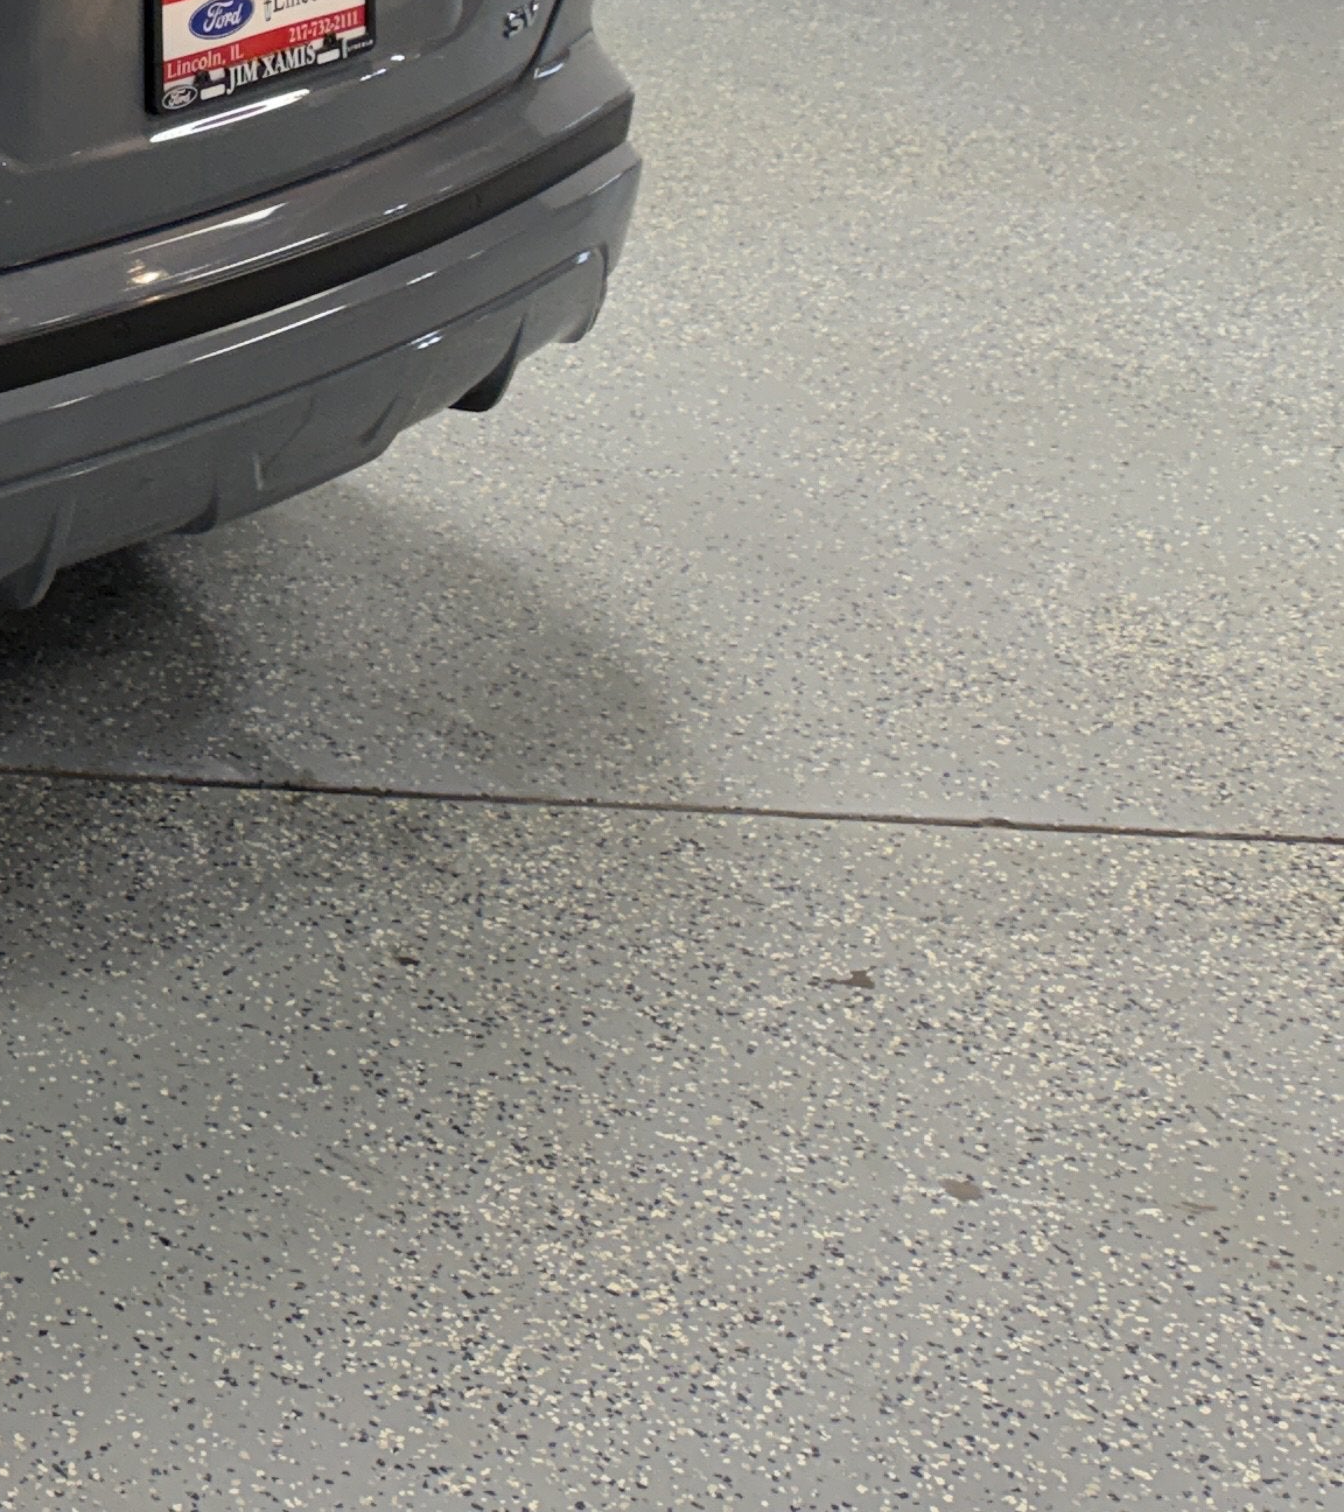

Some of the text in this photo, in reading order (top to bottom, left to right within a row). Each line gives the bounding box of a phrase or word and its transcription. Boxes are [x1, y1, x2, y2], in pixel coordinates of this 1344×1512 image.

[202, 0, 244, 34] Ford
[288, 9, 359, 43] 217-732-2111
[230, 43, 245, 61] IL
[226, 44, 316, 95] JIM XAMIS
